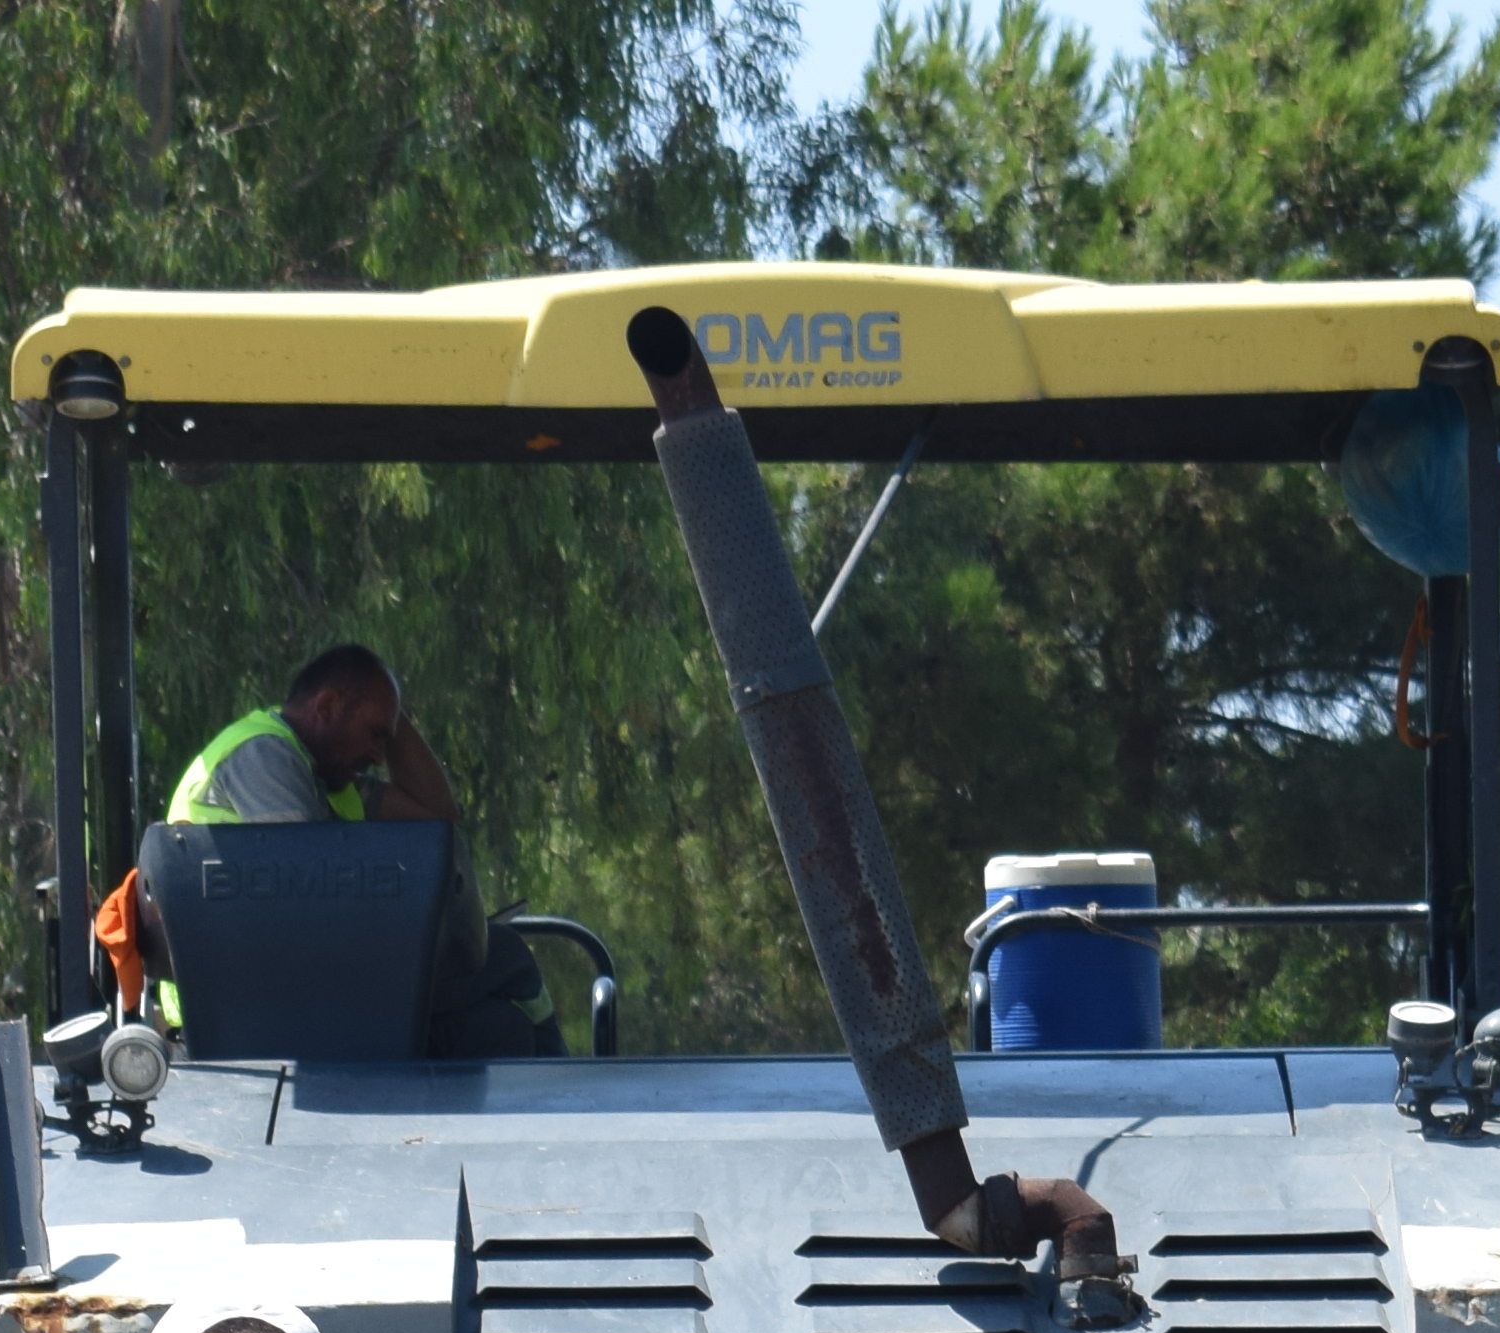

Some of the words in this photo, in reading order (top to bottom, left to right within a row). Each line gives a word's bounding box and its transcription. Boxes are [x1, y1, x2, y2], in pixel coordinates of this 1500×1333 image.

[681, 310, 901, 364] OMAG
[743, 371, 816, 388] FAYAT
[823, 370, 903, 387] GROUP
[201, 858, 405, 901] BOMAG
